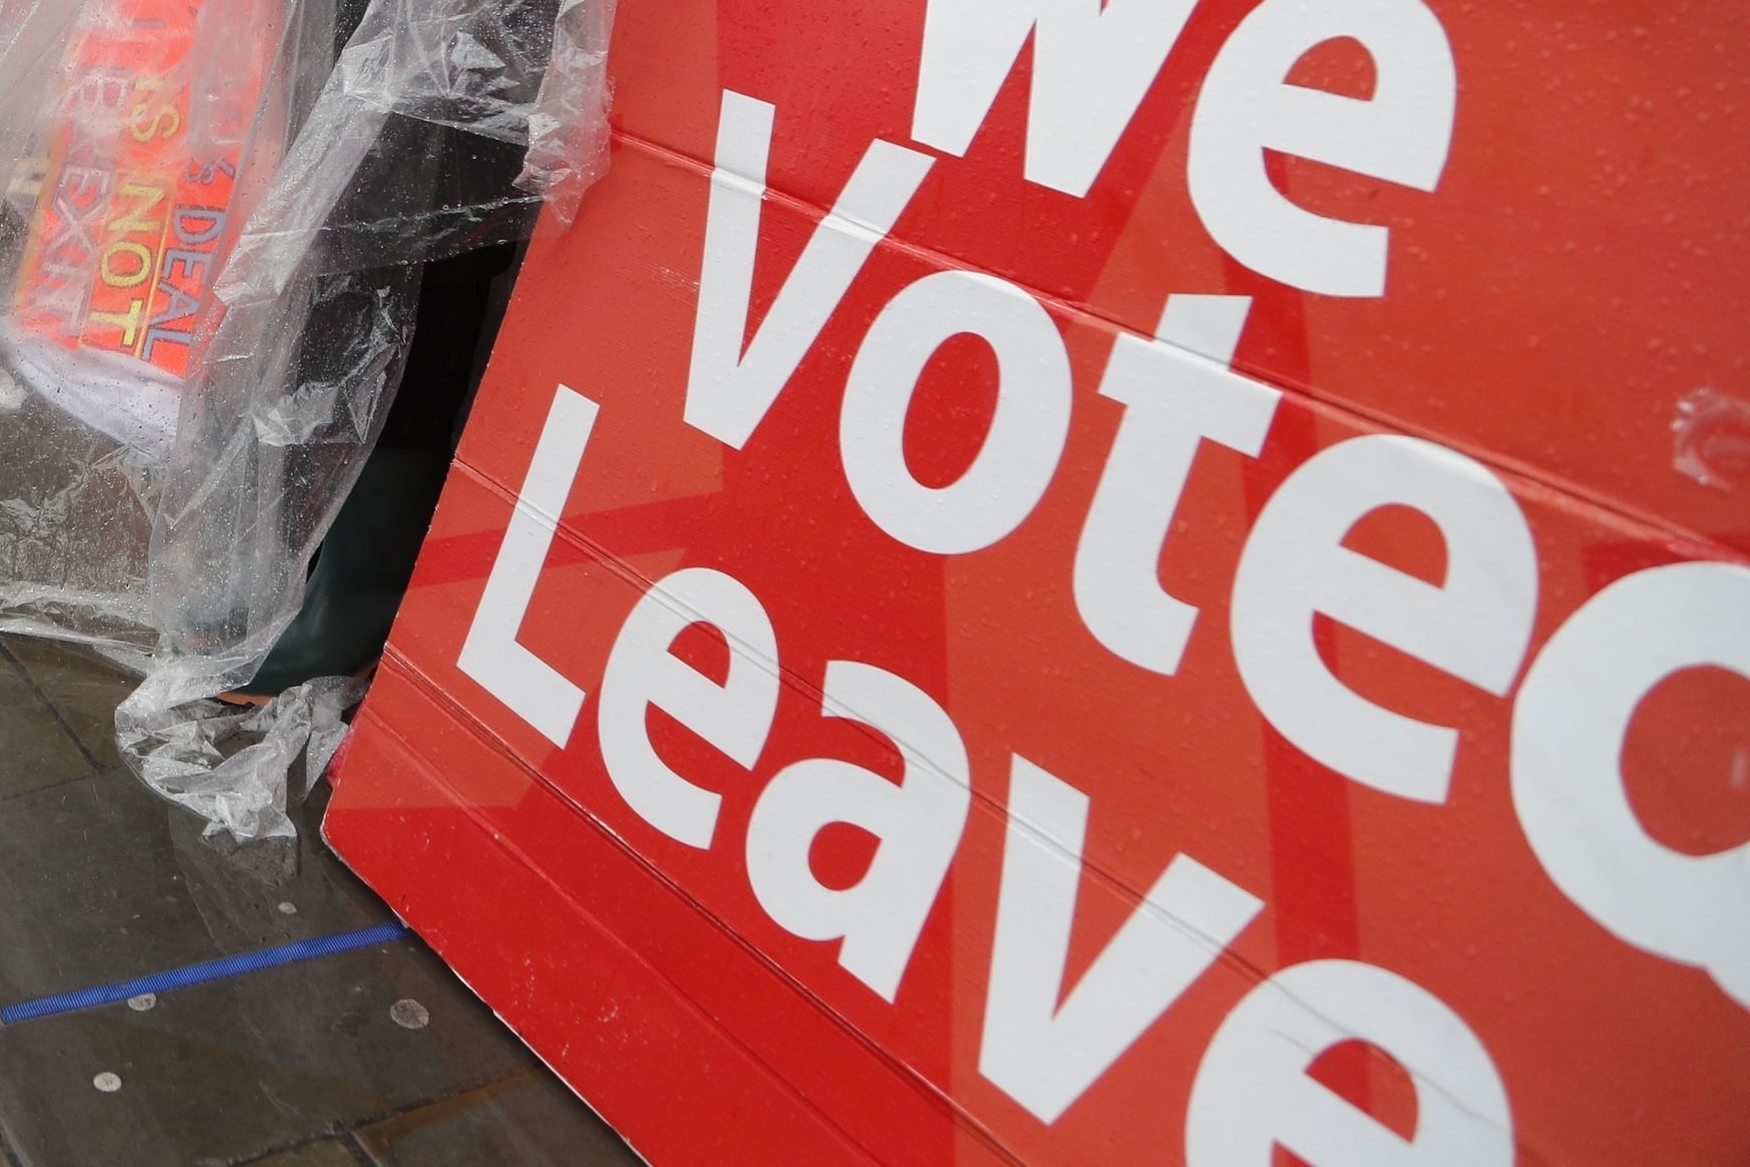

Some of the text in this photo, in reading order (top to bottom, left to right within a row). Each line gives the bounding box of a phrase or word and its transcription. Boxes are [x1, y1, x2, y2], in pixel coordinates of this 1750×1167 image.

[90, 74, 181, 347] IS NOT
[140, 205, 227, 360] DEAL
